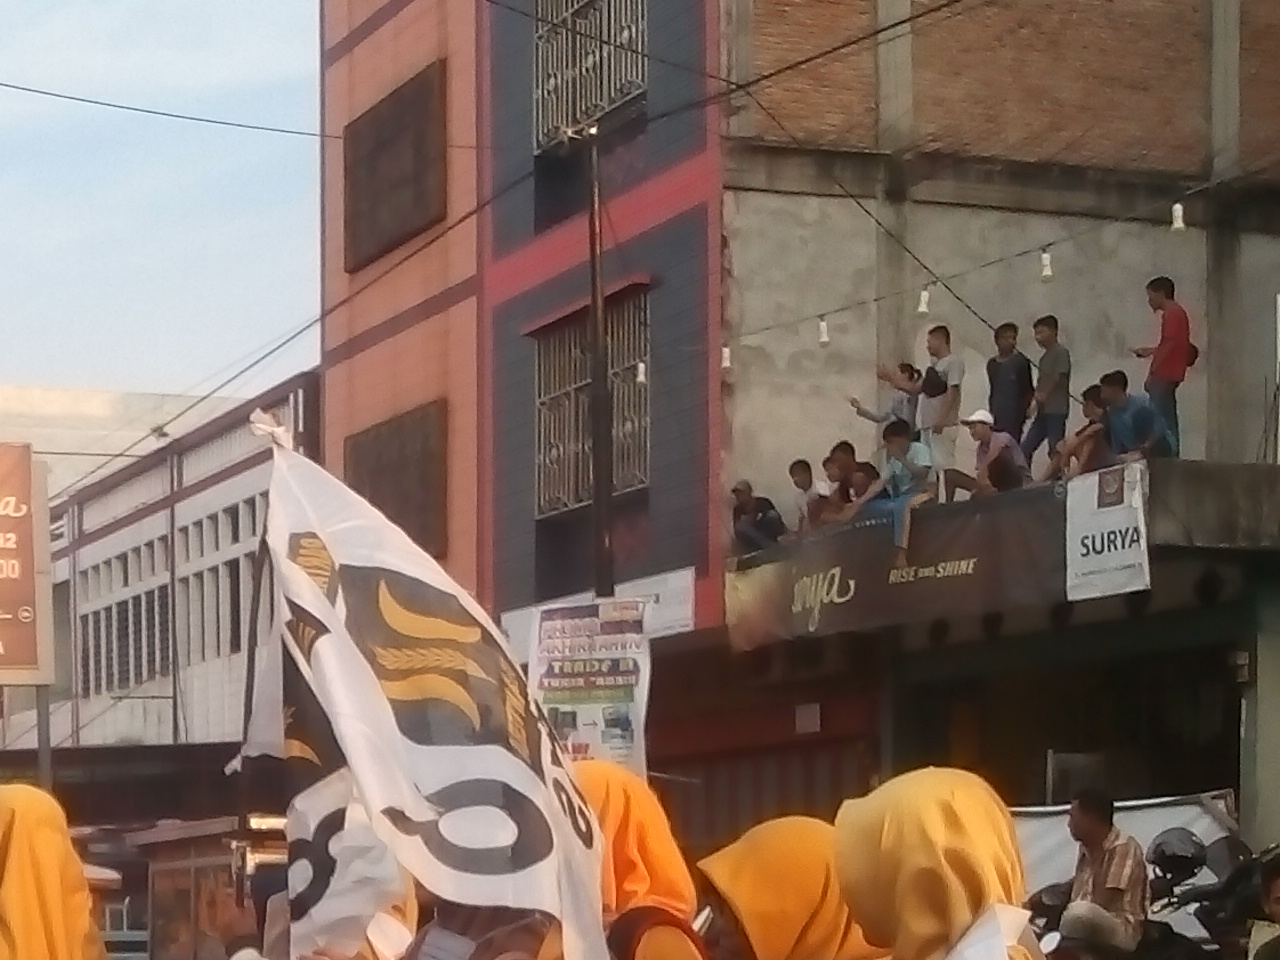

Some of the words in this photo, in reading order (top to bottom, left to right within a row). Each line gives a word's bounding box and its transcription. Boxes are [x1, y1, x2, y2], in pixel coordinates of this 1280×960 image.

[1080, 526, 1141, 558] SURYA
[888, 566, 917, 585] RISE
[936, 557, 978, 579] SHINE
